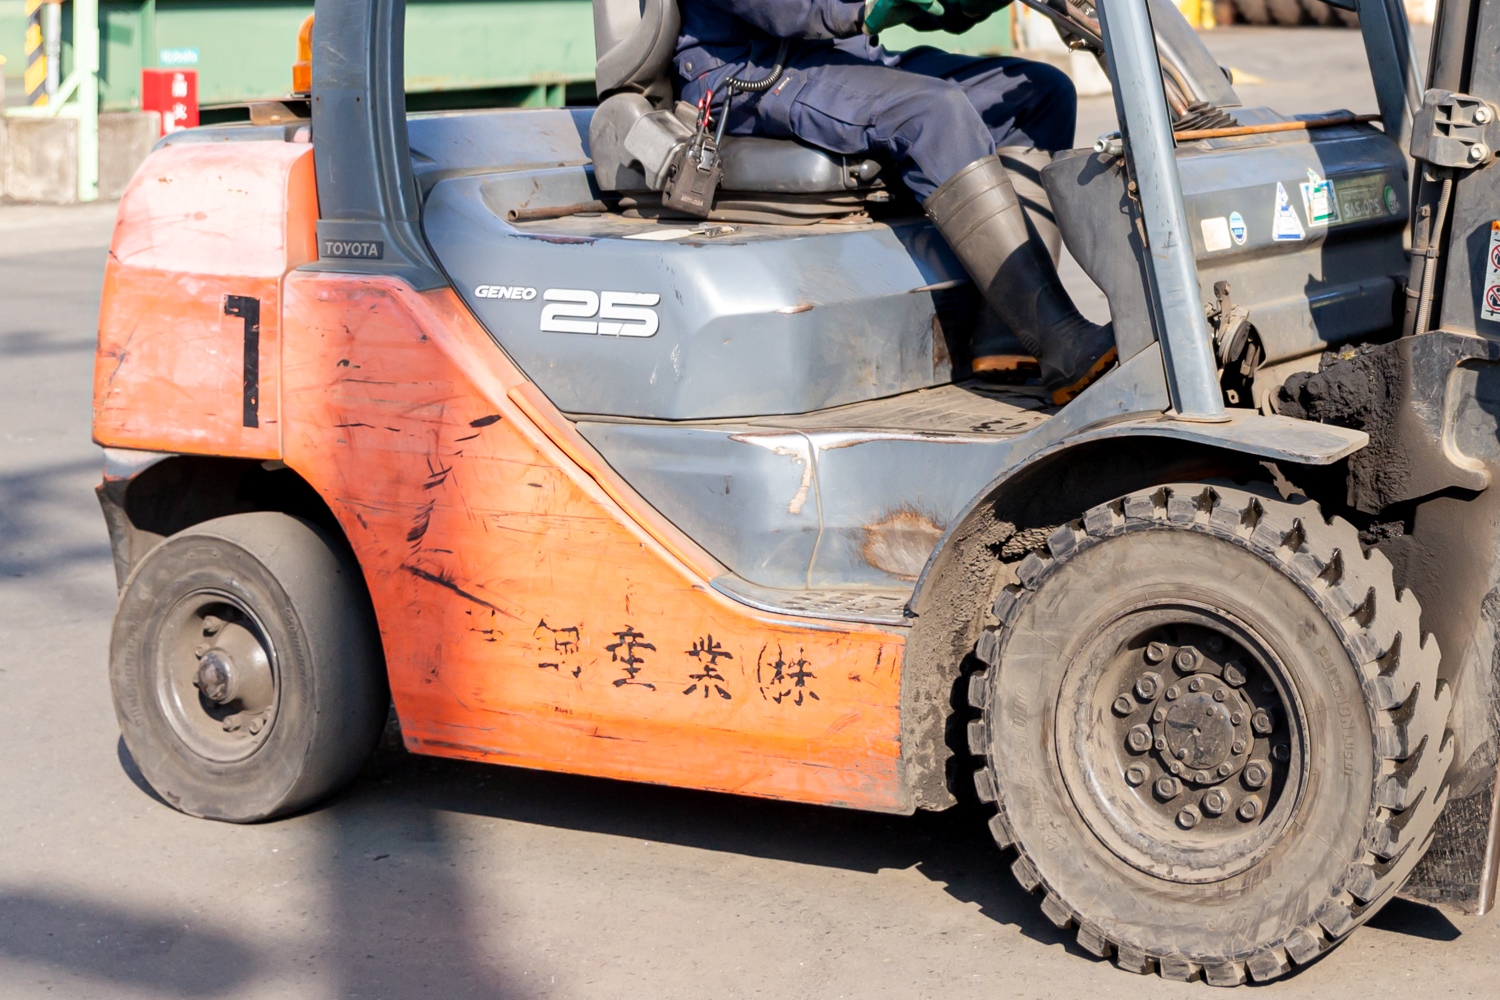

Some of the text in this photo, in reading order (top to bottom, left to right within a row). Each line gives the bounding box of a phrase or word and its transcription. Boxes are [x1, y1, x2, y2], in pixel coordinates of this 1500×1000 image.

[325, 241, 379, 257] TOYOTA
[474, 285, 660, 339] GENEO 25
[223, 293, 261, 429] 1
